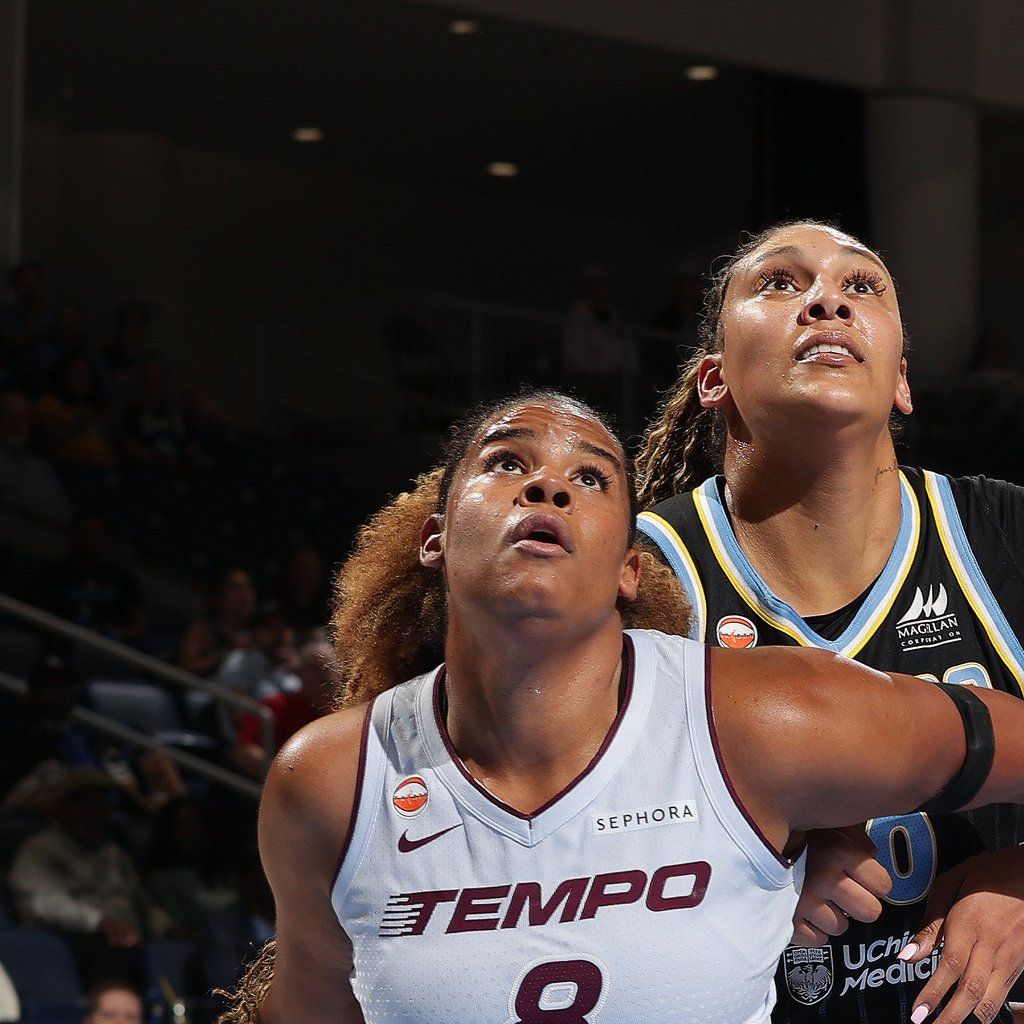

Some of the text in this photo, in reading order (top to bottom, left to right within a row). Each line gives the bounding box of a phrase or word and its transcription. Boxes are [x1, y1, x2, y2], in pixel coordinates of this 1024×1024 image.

[596, 804, 694, 831] SEPHORA
[379, 861, 712, 938] TEMPO
[842, 931, 945, 970] UChi
[840, 949, 941, 997] Medici
